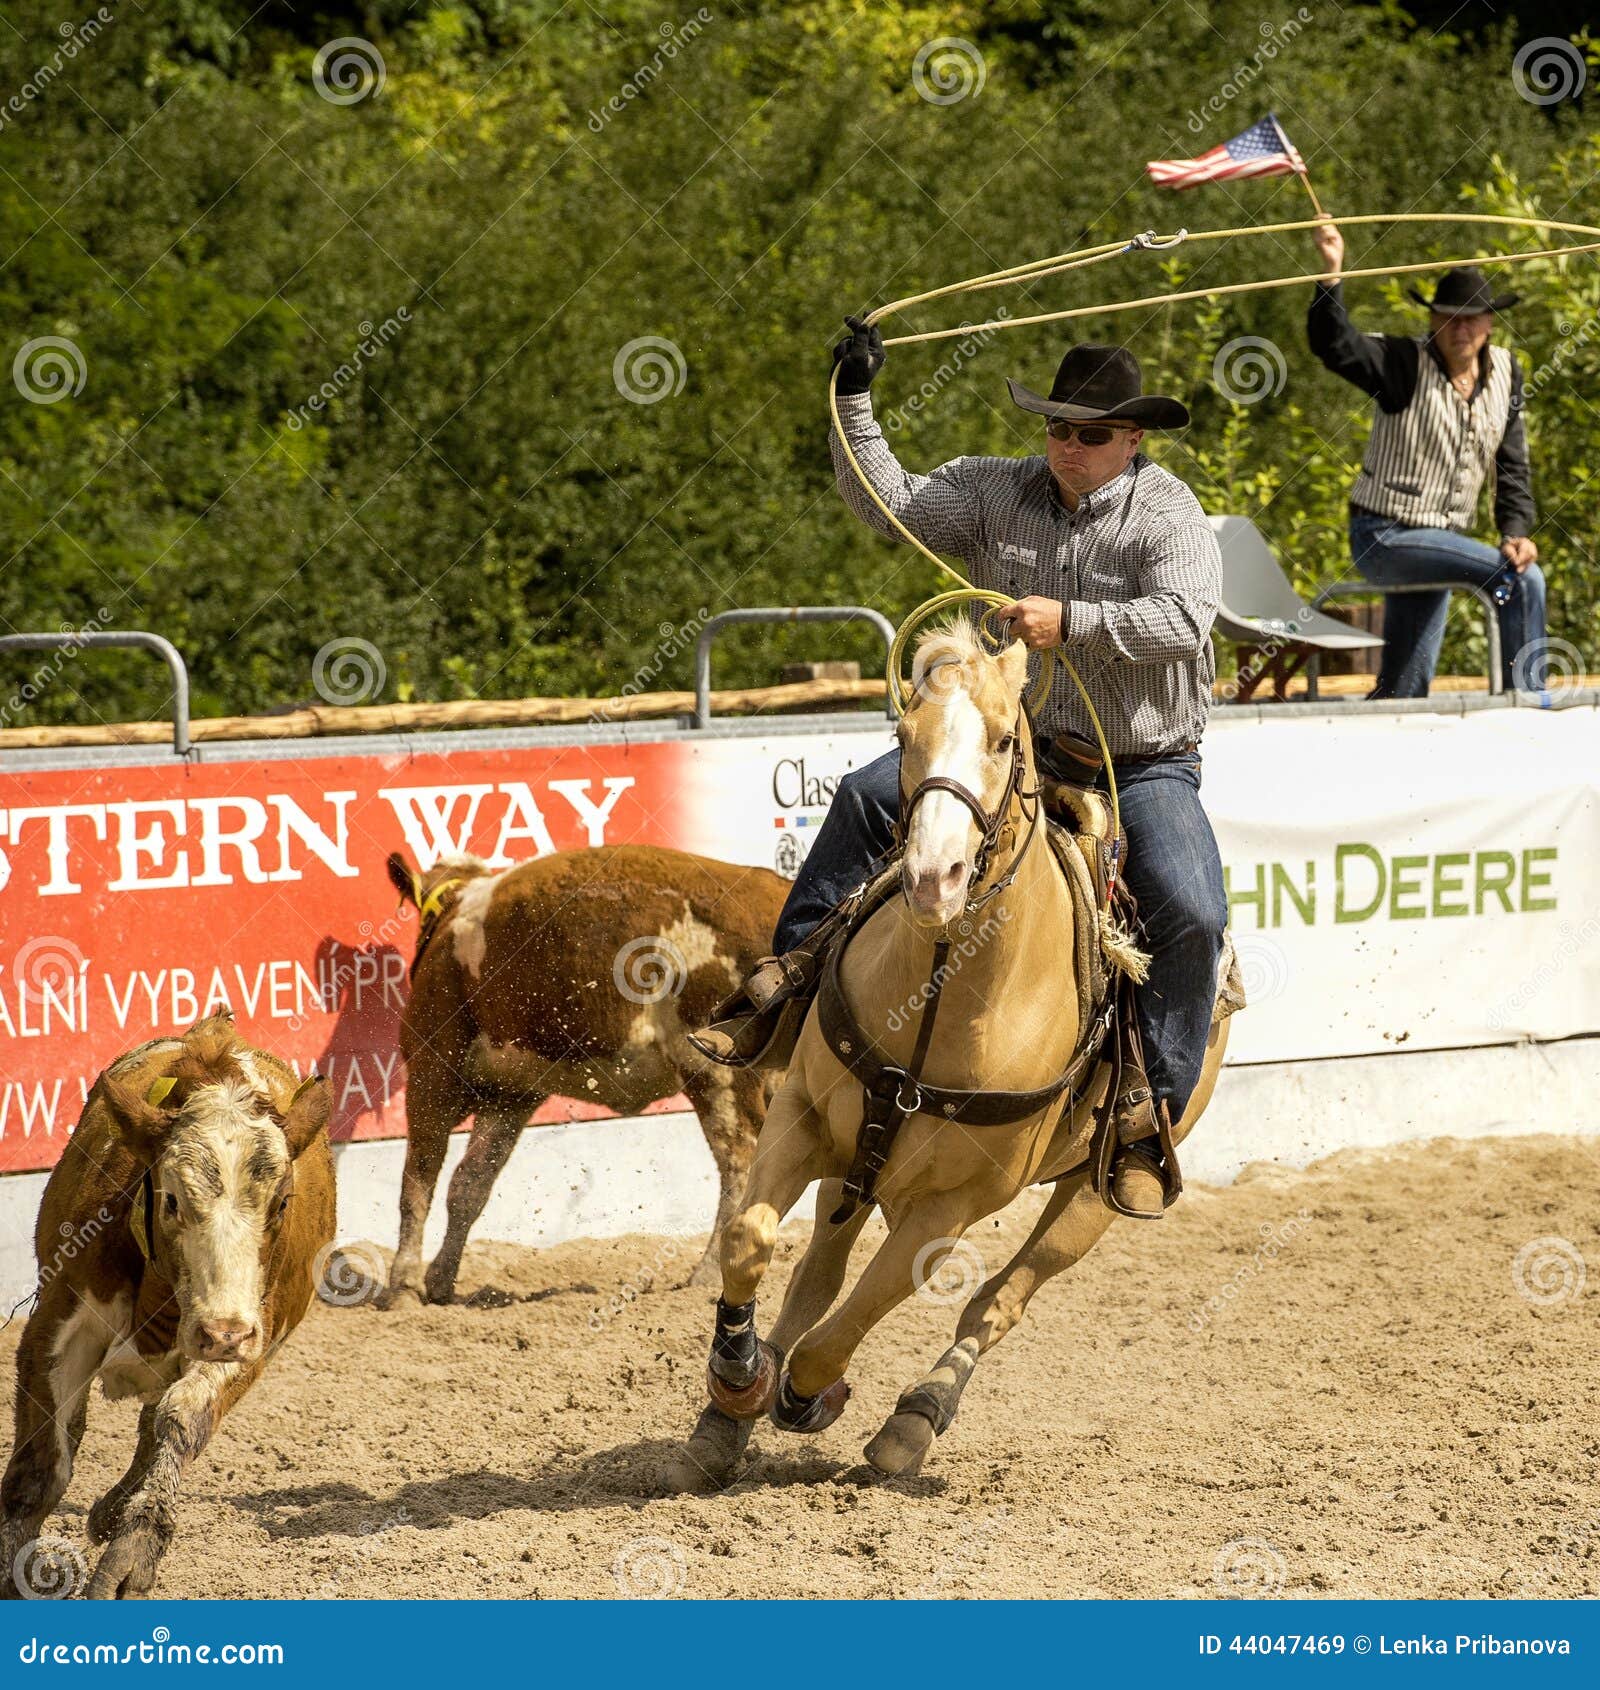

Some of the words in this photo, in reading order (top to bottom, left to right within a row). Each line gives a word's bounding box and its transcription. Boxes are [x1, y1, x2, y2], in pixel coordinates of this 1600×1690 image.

[0, 790, 360, 897] TERN
[378, 776, 636, 873] WAY
[1334, 842, 1558, 924] DEERE
[104, 942, 339, 1029] VYBAVENÍ
